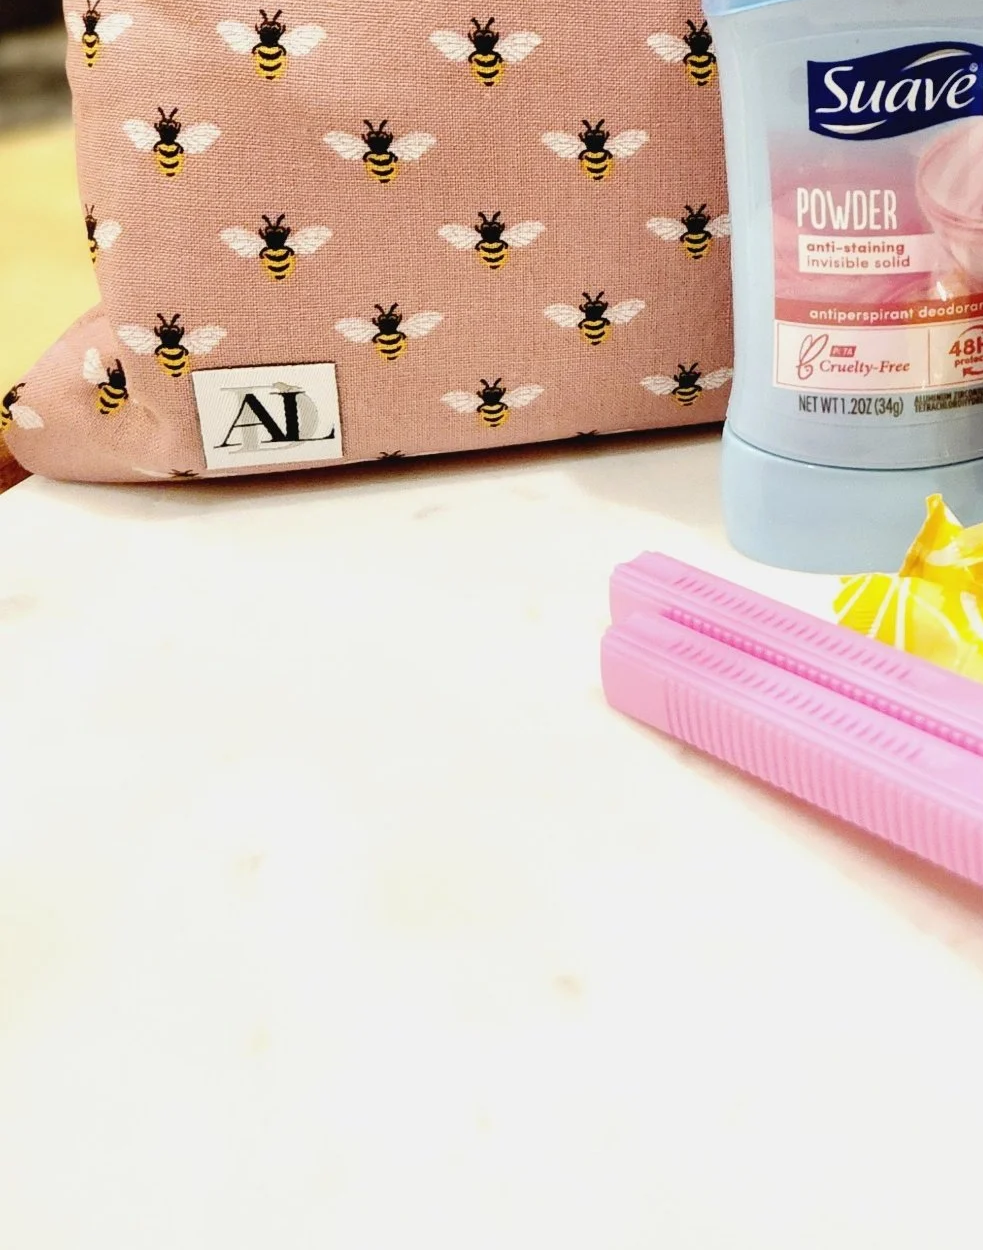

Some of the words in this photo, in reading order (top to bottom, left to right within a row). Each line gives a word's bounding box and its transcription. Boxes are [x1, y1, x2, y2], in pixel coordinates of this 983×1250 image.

[796, 187, 898, 231] POWDER
[806, 240, 905, 256] anti-staining
[806, 255, 870, 270] invisible
[873, 254, 911, 269] solid
[809, 307, 914, 325] antiperspirant
[819, 360, 910, 378] Cruelty-Free
[798, 395, 818, 413] NET
[820, 396, 838, 414] WT
[874, 397, 904, 418] (34g)
